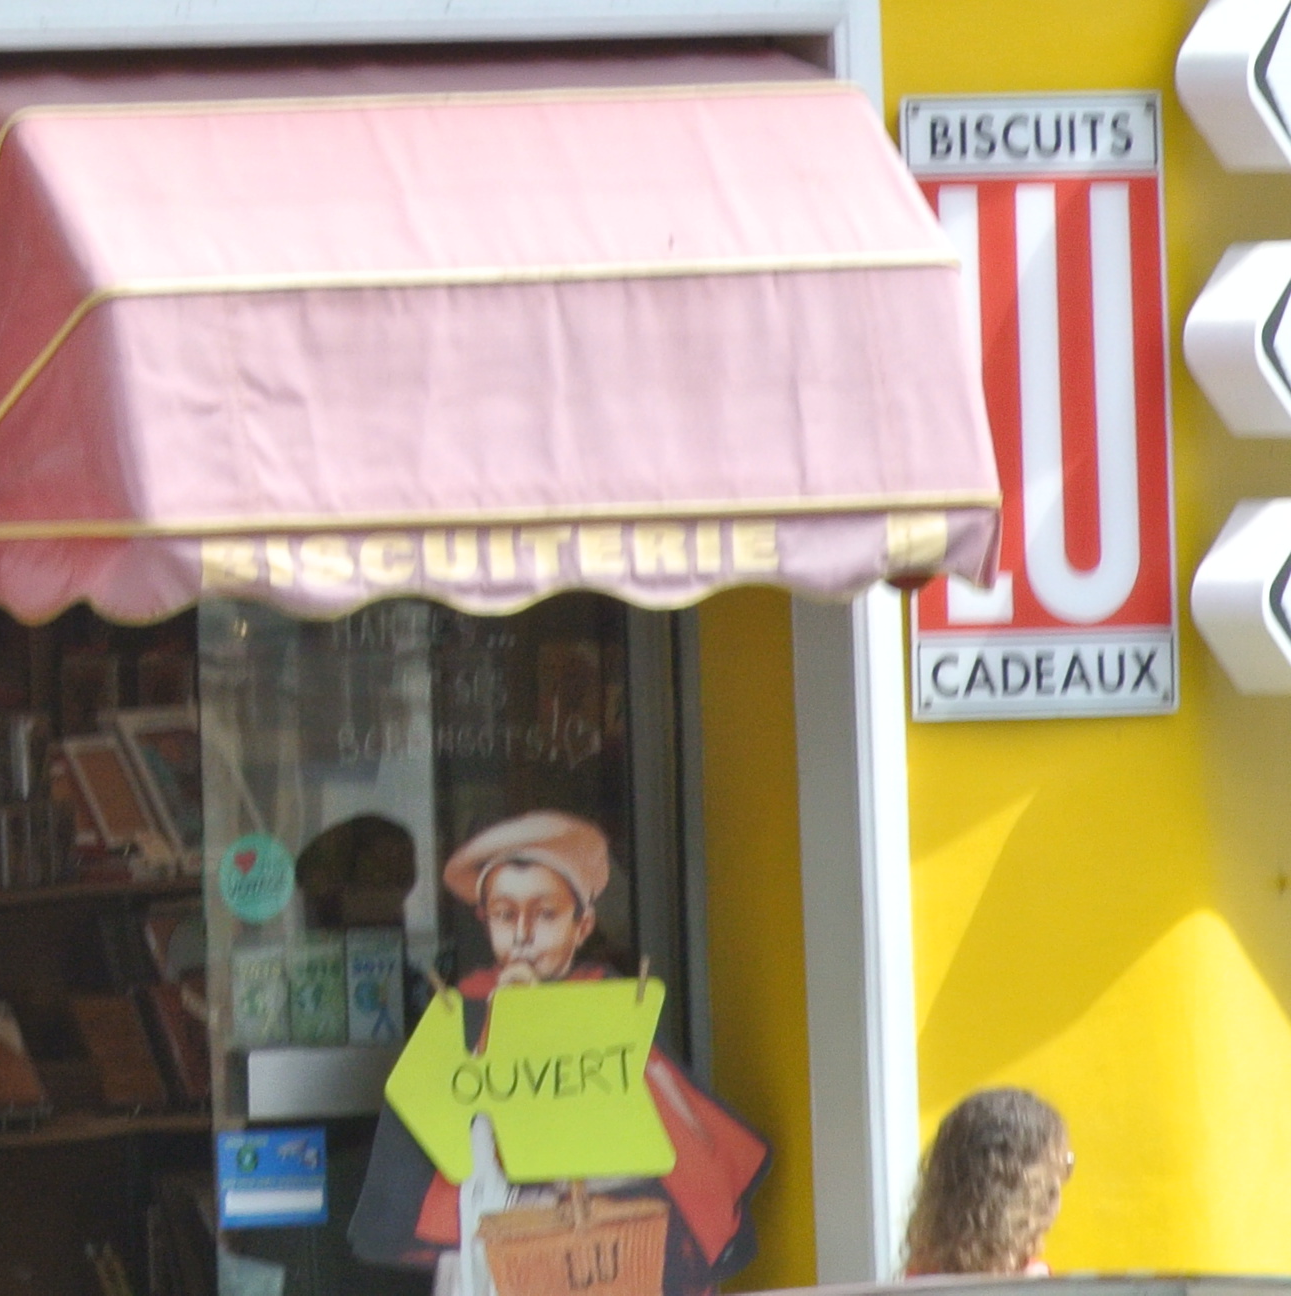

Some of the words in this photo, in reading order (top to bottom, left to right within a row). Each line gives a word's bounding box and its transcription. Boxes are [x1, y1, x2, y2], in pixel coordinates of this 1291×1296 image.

[928, 112, 1134, 160] BISCUITS
[937, 180, 1141, 625] LU
[200, 519, 781, 588] BISCUITERIE
[930, 648, 1162, 702] CADEAUX
[450, 1041, 638, 1106] OUVERT
[564, 1236, 621, 1292] LU
